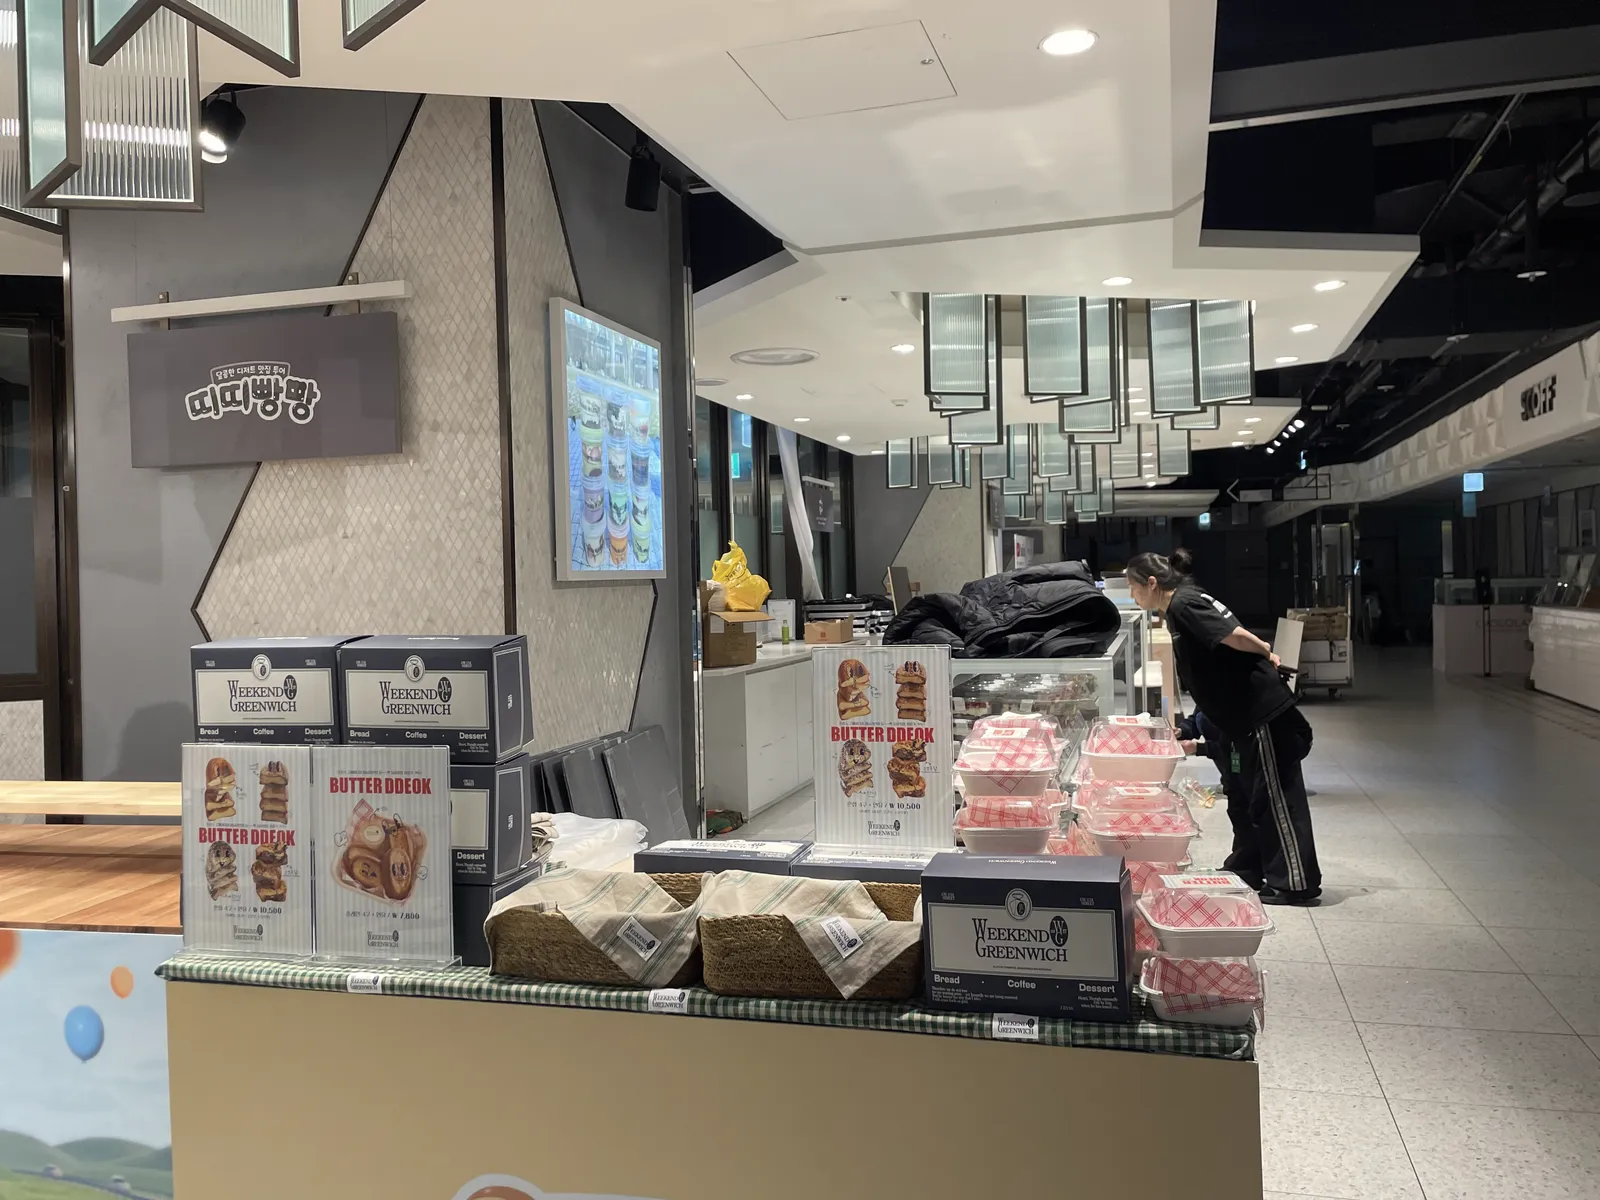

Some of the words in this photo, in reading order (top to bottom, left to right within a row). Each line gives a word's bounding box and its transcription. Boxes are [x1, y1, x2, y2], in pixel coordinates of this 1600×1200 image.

[216, 368, 234, 380] 달콤한
[236, 366, 256, 374] 디저트
[258, 366, 270, 374] 맛집
[273, 366, 286, 374] 투어
[228, 680, 284, 698] WEEKEND
[379, 681, 438, 700] WEEKEND
[230, 694, 296, 712] GREENWICH
[382, 697, 451, 715] GREENWICH
[350, 730, 370, 738] Bread
[459, 732, 487, 740] Dessert
[831, 726, 884, 742] BUTTER
[887, 728, 934, 743] DDEOK
[330, 777, 382, 794] BUTTER
[385, 778, 432, 794] DDEOK
[198, 828, 248, 844] BUTTER
[250, 829, 296, 846] DDEOK
[457, 852, 484, 860] Dessert
[972, 918, 1050, 942] WEEKEND
[976, 937, 1068, 962] GREENWICH
[934, 974, 960, 984] Bread
[1008, 980, 1036, 989] Coffee
[1079, 984, 1115, 993] Dessert
